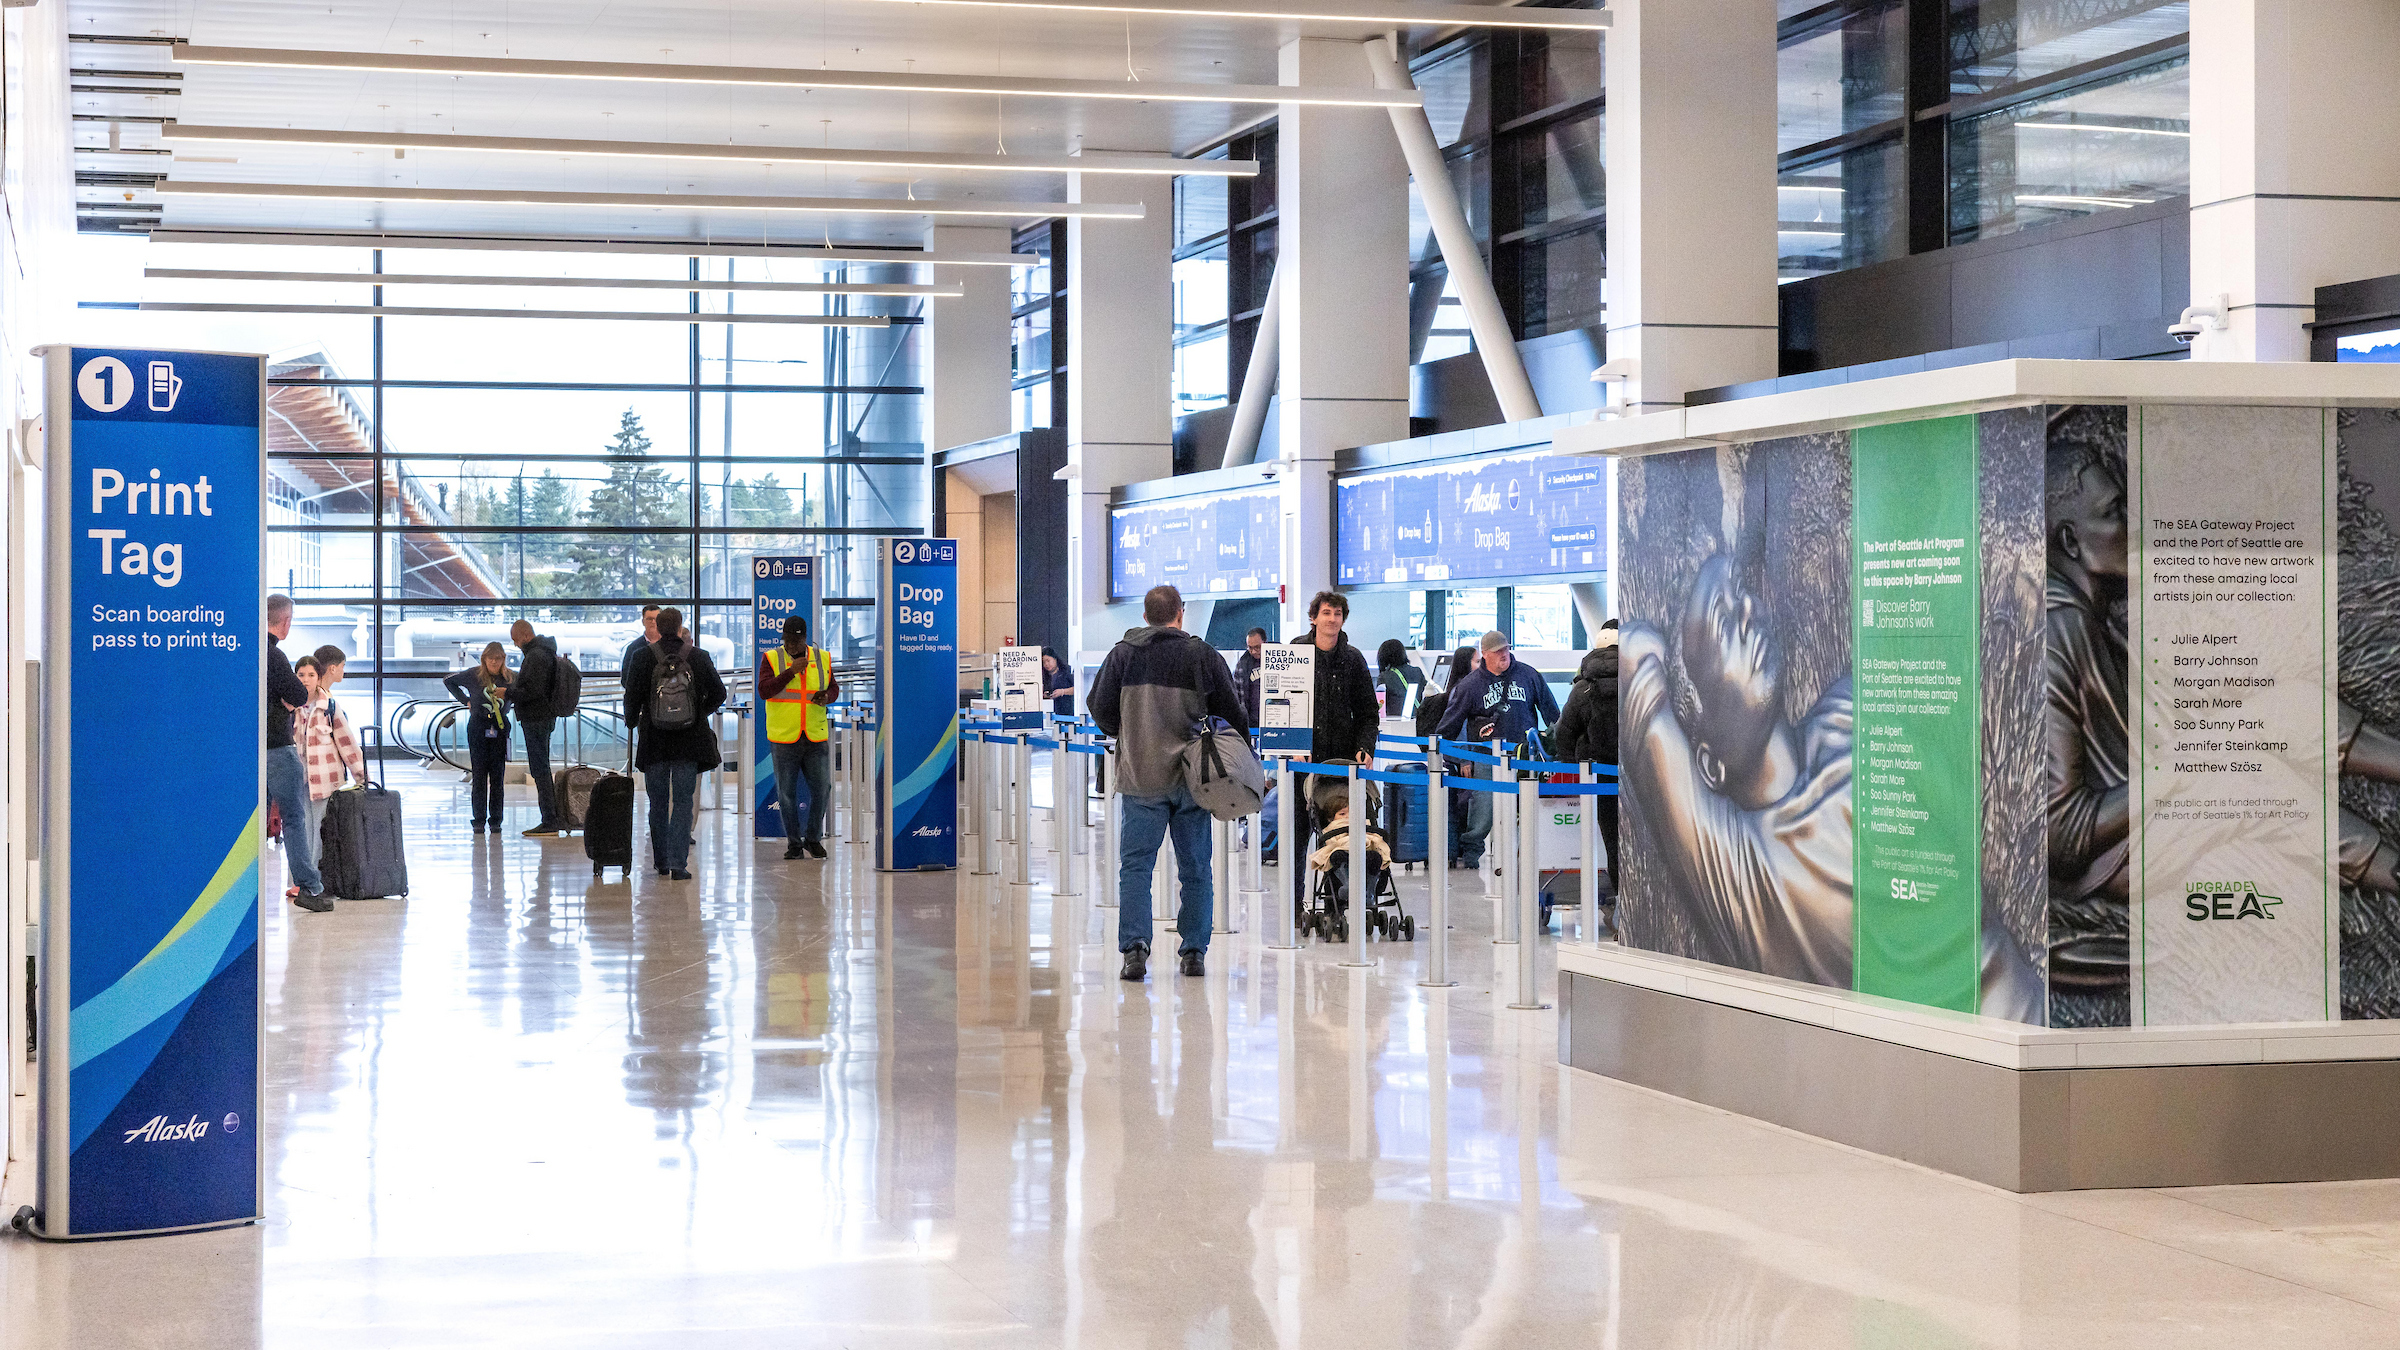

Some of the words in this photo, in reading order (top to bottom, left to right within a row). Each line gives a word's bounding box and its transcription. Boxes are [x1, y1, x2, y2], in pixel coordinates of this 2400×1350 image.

[96, 366, 113, 404] 1
[92, 468, 212, 516] Print
[1463, 482, 1501, 516] Alaska
[2153, 519, 2174, 530] The
[2177, 519, 2198, 529] SEA
[2200, 520, 2252, 533] Gateway
[2255, 520, 2295, 533] Project
[1474, 527, 1493, 552] Drop
[1495, 526, 1510, 551] Bag
[1864, 542, 1874, 553] The
[1875, 541, 1888, 552] Port
[1889, 540, 1897, 552] of
[1898, 538, 1922, 551] Seattle
[1923, 538, 1934, 550] Art
[1935, 538, 1964, 551] Program
[2153, 537, 2176, 548] and
[2180, 537, 2198, 548] the
[2201, 538, 2224, 548] Port
[2227, 537, 2239, 548] of
[2241, 538, 2281, 548] Seattle
[2284, 540, 2304, 548] are
[88, 529, 182, 588] Tag
[900, 545, 910, 559] 2
[759, 562, 766, 574] 2
[1125, 559, 1136, 575] Drop
[1137, 558, 1146, 577] Bag
[1864, 558, 1890, 572] presents
[1891, 559, 1905, 568] new
[1906, 557, 1916, 568] art
[1918, 555, 1942, 569] coming
[1944, 556, 1960, 566] soon
[2153, 556, 2195, 566] excited
[2198, 557, 2210, 566] to
[2213, 556, 2241, 566] have
[2244, 557, 2268, 566] new
[2270, 556, 2315, 566] artwork
[1864, 577, 1870, 587] to
[1871, 575, 1882, 586] this
[1883, 576, 1903, 589] space
[1905, 574, 1913, 588] by
[1914, 574, 1932, 587] Barry
[1933, 572, 1962, 584] Johnson
[2153, 573, 2180, 583] from
[2183, 573, 2215, 584] these
[2218, 574, 2267, 586] amazing
[2270, 574, 2298, 584] local
[900, 583, 943, 605] Drop
[2153, 591, 2190, 602] artists
[2191, 592, 2213, 604] join
[2216, 593, 2235, 601] our
[2237, 592, 2296, 602] collection:
[759, 595, 796, 613] Drop
[1876, 600, 1908, 612] Discover
[1910, 599, 1930, 615] Barry
[92, 604, 140, 623] Scan
[148, 605, 224, 627] boarding
[900, 606, 933, 628] Bag
[1876, 615, 1914, 628] Johnson's
[1915, 614, 1934, 628] work
[759, 614, 785, 633] Bag
[92, 634, 136, 651] pass
[142, 632, 161, 647] to
[167, 630, 207, 651] print
[212, 632, 241, 651] tag.
[2171, 634, 2199, 645] Julie
[2202, 634, 2238, 647] Alpert
[900, 644, 923, 652] tagged
[925, 644, 936, 652] bag
[938, 644, 953, 652] ready.
[1862, 659, 1872, 669] SEA
[1873, 659, 1899, 672] Gateway
[1901, 659, 1921, 671] Project
[1922, 659, 1935, 669] and
[1936, 659, 1946, 670] the
[2174, 656, 2206, 668] Barry
[2207, 656, 2258, 666] Johnson
[1862, 673, 1873, 683] Port
[1875, 673, 1881, 684] of
[1882, 673, 1902, 684] Seattle
[1903, 675, 1913, 684] are
[1915, 674, 1937, 684] excited
[1938, 675, 1944, 684] to
[1946, 674, 1961, 685] have
[2174, 677, 2221, 689] Morgan
[2224, 677, 2275, 687] Madison
[1862, 690, 1874, 698] new
[1875, 688, 1897, 698] artwork
[1898, 688, 1912, 698] from
[1913, 688, 1930, 699] these
[1931, 689, 1958, 702] amazing
[1862, 701, 1876, 712] local
[1877, 702, 1895, 712] artists
[1895, 702, 1907, 715] join
[1908, 704, 1918, 713] our
[1919, 703, 1950, 714] collection:
[2173, 698, 2209, 709] Sarah
[2212, 698, 2242, 708] More
[1869, 725, 1883, 735] Julie
[1884, 725, 1902, 738] Alpert
[2173, 720, 2196, 730] Soo
[2199, 719, 2235, 732] Sunny
[2238, 719, 2264, 730] Park
[1870, 740, 1887, 754] Barry
[1887, 741, 1913, 753] Johnson
[2174, 740, 2223, 751] Jennifer
[2225, 740, 2288, 752] Steinkamp
[1870, 757, 1894, 770] Morgan
[1895, 758, 1922, 770] Madison
[2174, 762, 2228, 773] Matthew
[2230, 762, 2262, 772] Szösz
[1870, 772, 1888, 784] Sarah
[1889, 774, 1905, 785] More
[1870, 789, 1882, 800] Soo
[1883, 789, 1901, 803] Sunny
[1902, 791, 1916, 802] Park
[2155, 799, 2172, 808] This
[2174, 799, 2202, 809] public
[2228, 798, 2261, 807] funded
[2263, 798, 2298, 809] through
[1871, 805, 1895, 817] Jennifer
[1896, 806, 1929, 822] Steinkamp
[2154, 812, 2170, 820] the
[2172, 812, 2192, 820] Port
[2192, 811, 2202, 820] of
[2203, 811, 2241, 820] Seattle's
[2254, 810, 2267, 819] for
[2268, 810, 2282, 819] Art
[2284, 810, 2309, 820] Policy
[912, 826, 942, 836] Alaska
[1871, 821, 1897, 833] Matthew
[1891, 878, 1918, 901] SEA
[2186, 881, 2253, 893] UPGRADE
[2186, 893, 2265, 921] SEA
[124, 1114, 209, 1143] Alaska
